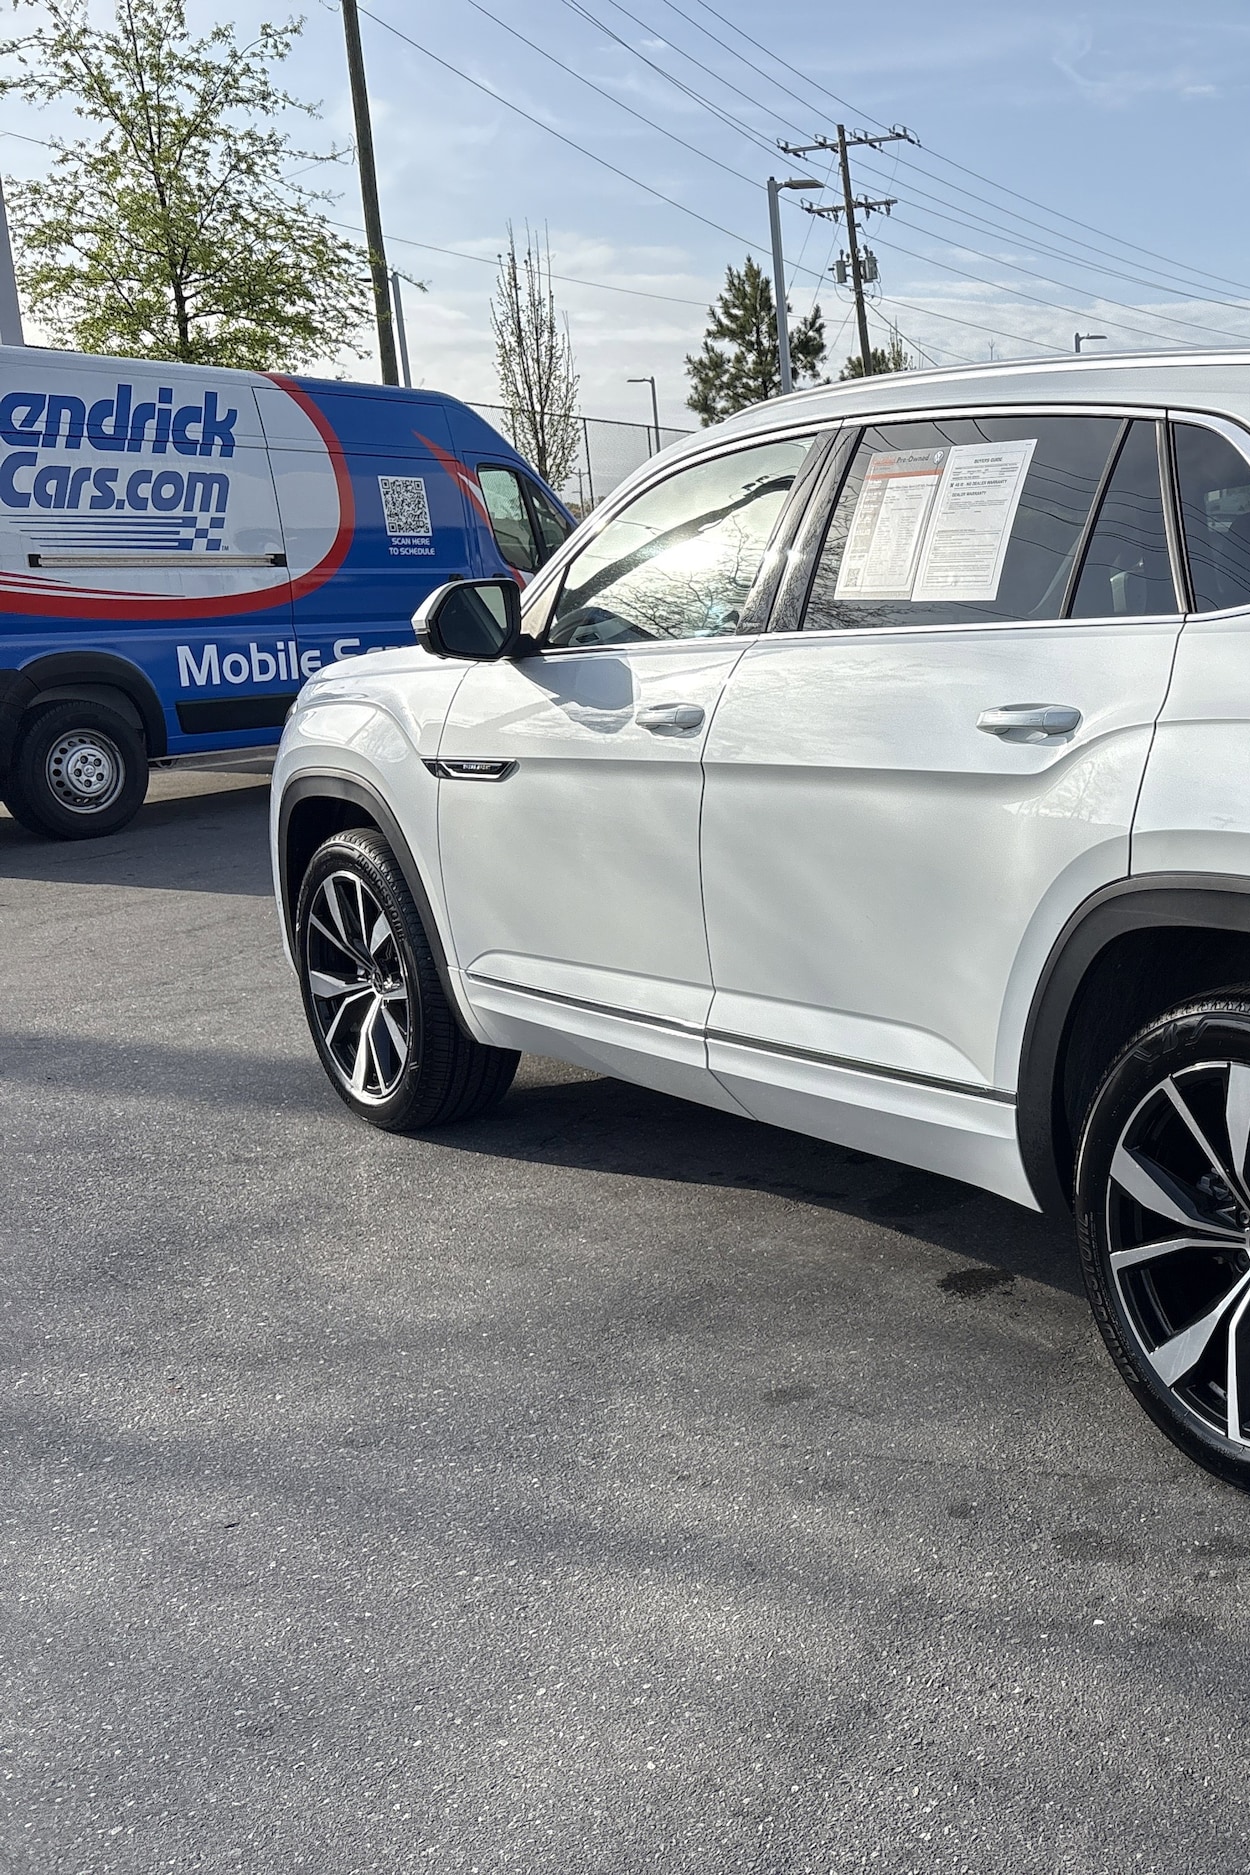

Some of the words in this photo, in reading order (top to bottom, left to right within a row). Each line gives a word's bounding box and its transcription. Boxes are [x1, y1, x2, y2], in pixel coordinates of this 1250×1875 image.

[0, 451, 230, 513] Cars.com
[389, 547, 399, 555] TO
[400, 547, 436, 556] SCHEDULE
[391, 537, 411, 546] SCAN
[412, 537, 431, 546] HERE
[176, 640, 321, 687] Mobile
